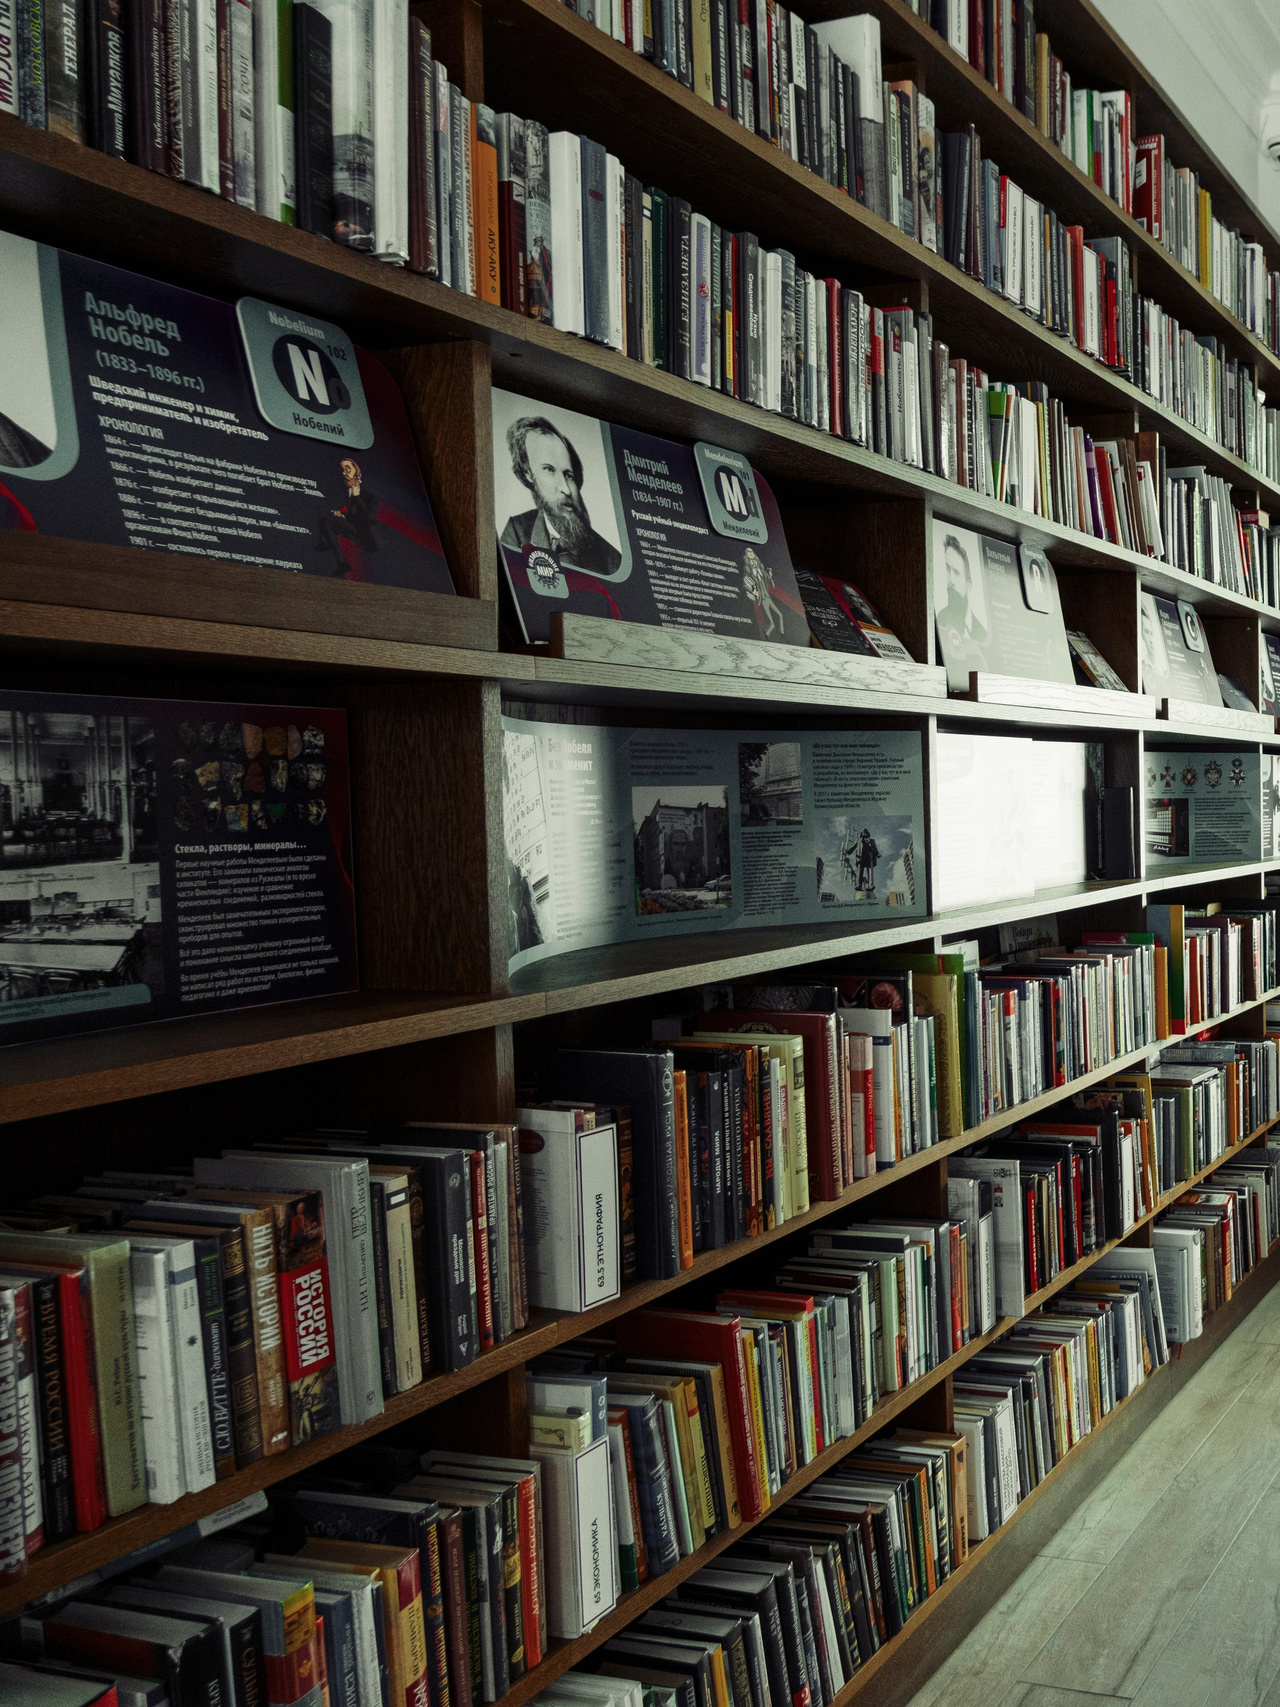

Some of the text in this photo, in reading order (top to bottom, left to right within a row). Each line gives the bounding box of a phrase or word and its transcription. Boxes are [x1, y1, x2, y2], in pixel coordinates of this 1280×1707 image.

[62, 3, 78, 80] ГЕНЕРАЛ
[241, 53, 252, 95] СОЧИ
[781, 50, 790, 131] МАРШАЛ ЖУКОВ
[487, 228, 497, 281] АКУ-АКУ
[679, 234, 691, 323] ЕЛИЗАВЕТА
[85, 291, 182, 341] Альфред
[88, 315, 170, 357] Нобель
[268, 310, 325, 339] Nobelium
[327, 345, 348, 361] 102
[89, 375, 240, 423] Шведский инженер химик,
[92, 391, 269, 441] предприниматель изобретатель
[98, 415, 165, 440] ХРОНОЛОГИЯ
[292, 412, 345, 438] Нобелий
[147, 468, 175, 481] Нобель
[242, 463, 267, 476] Нобеля
[275, 472, 318, 489] производству
[256, 477, 294, 491] брат Нобеля
[624, 449, 669, 475] Дмитрий
[627, 467, 684, 495] Менделеев
[129, 535, 303, 572] 1901 состоялось первое награждение лауреата
[171, 527, 192, 539] Фонд
[191, 530, 220, 543] Нобеля.
[216, 525, 262, 540] волей Нобеля
[636, 528, 668, 542] ХРОНОЛОГИЯ
[536, 565, 554, 577] МИР
[174, 842, 207, 855] Стекла,
[208, 843, 253, 854] растворы,
[678, 1093, 686, 1125] словарь
[733, 1087, 741, 1125] НАРОДА
[663, 1110, 675, 1197] НАРОДНАЯ РУСЬ
[689, 1096, 699, 1187] РЕКВИЕМ ЭТНОСУ
[713, 1130, 721, 1156] МИРА
[794, 1112, 802, 1158] РУССКИЙ
[355, 1171, 367, 1236] ВЕЛИКИЙ
[486, 1160, 496, 1226] ПРАВИТЕЛИ РОССИИ
[350, 1205, 361, 1240] ПЕТР
[595, 1193, 606, 1288] 63.5 ЭТНОГРАФИЯ
[682, 1199, 690, 1246] Российский
[356, 1239, 368, 1287] Павленко
[983, 1240, 991, 1262] ИГРЫ
[252, 1223, 280, 1350] НИТЬ ИСТОРИИ
[479, 1232, 493, 1327] НИКОЛАЙ КАРАМЗИН
[294, 1274, 319, 1367] РОССИИ
[312, 1268, 331, 1361] ИСТОРИЯ
[417, 1297, 430, 1364] ИВАН КАЛИТА
[40, 1303, 65, 1453] ВРЕМЯ РОССИИ
[700, 1453, 715, 1519] Инвестиции
[656, 1492, 669, 1538] КУЛЬТУРА
[527, 1499, 540, 1615] ДОЧЕРИ РОССИИ
[591, 1517, 602, 1605] 65 ЭКОНОМИКА
[870, 1551, 881, 1590] КАПИТАЛ
[425, 1523, 446, 1677] РОССИЙСКАЯ ИСТОРИЯ
[468, 1550, 481, 1673] ИСКУССТВЕ КОСТЮМЕ
[768, 1608, 778, 1637] УЧЕТ
[774, 1604, 792, 1705] УПРАВЛЕНЧЕСКИЙ
